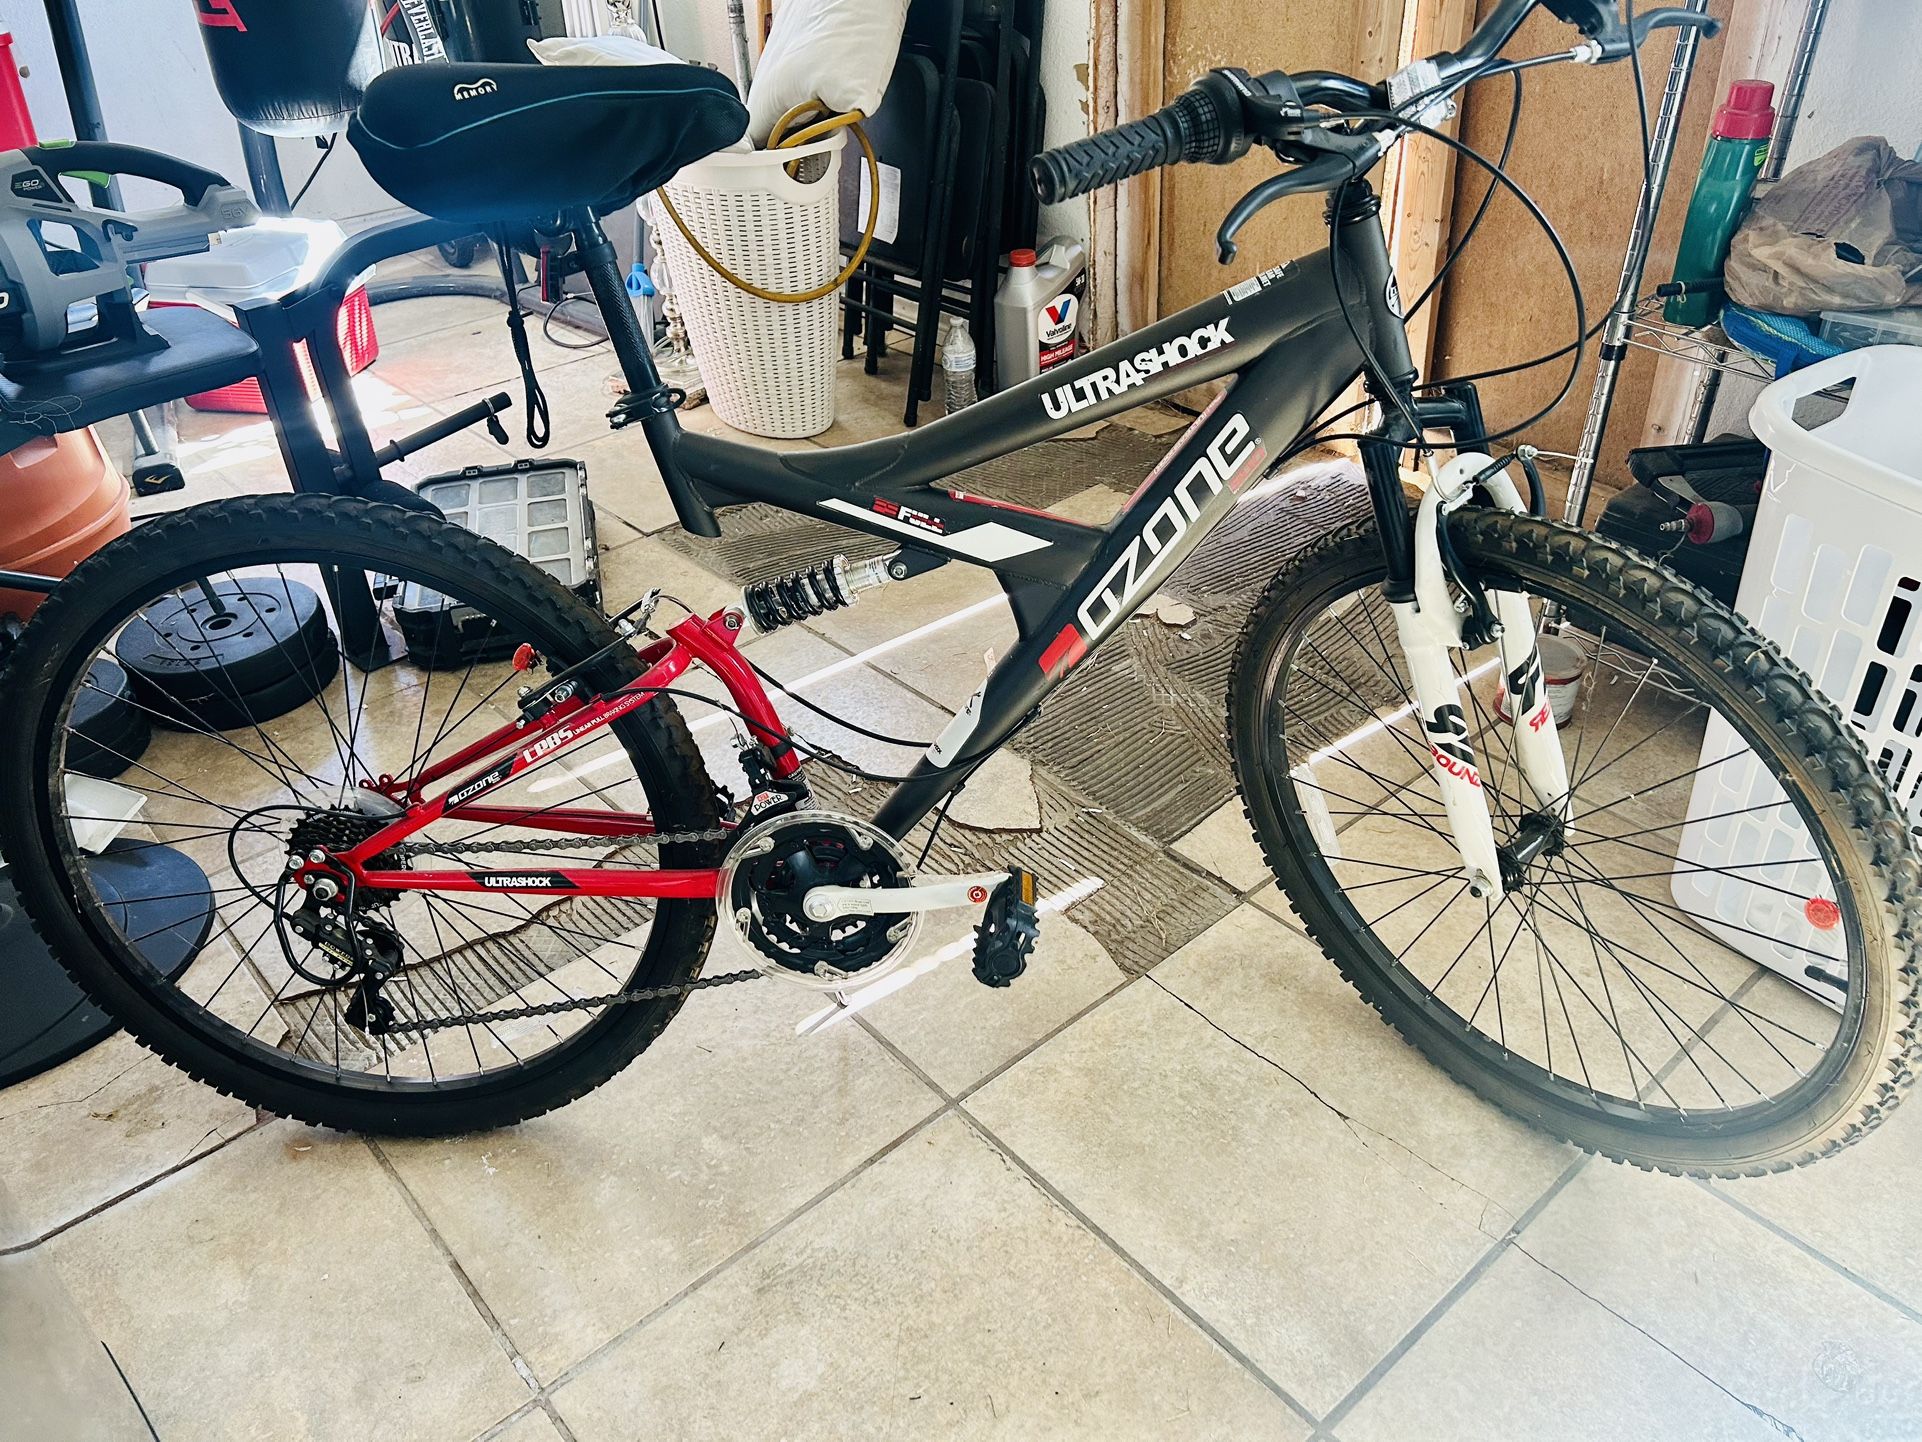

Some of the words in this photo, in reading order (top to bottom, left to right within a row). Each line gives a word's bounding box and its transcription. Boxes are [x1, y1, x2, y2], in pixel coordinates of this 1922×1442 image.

[455, 85, 498, 101] MEMORY
[15, 179, 39, 189] EGO
[1046, 322, 1072, 338] Valvoline
[1040, 316, 1235, 420] ULTRASHOCK
[754, 794, 783, 811] POWER
[484, 876, 552, 887] ULTRASHOCK
